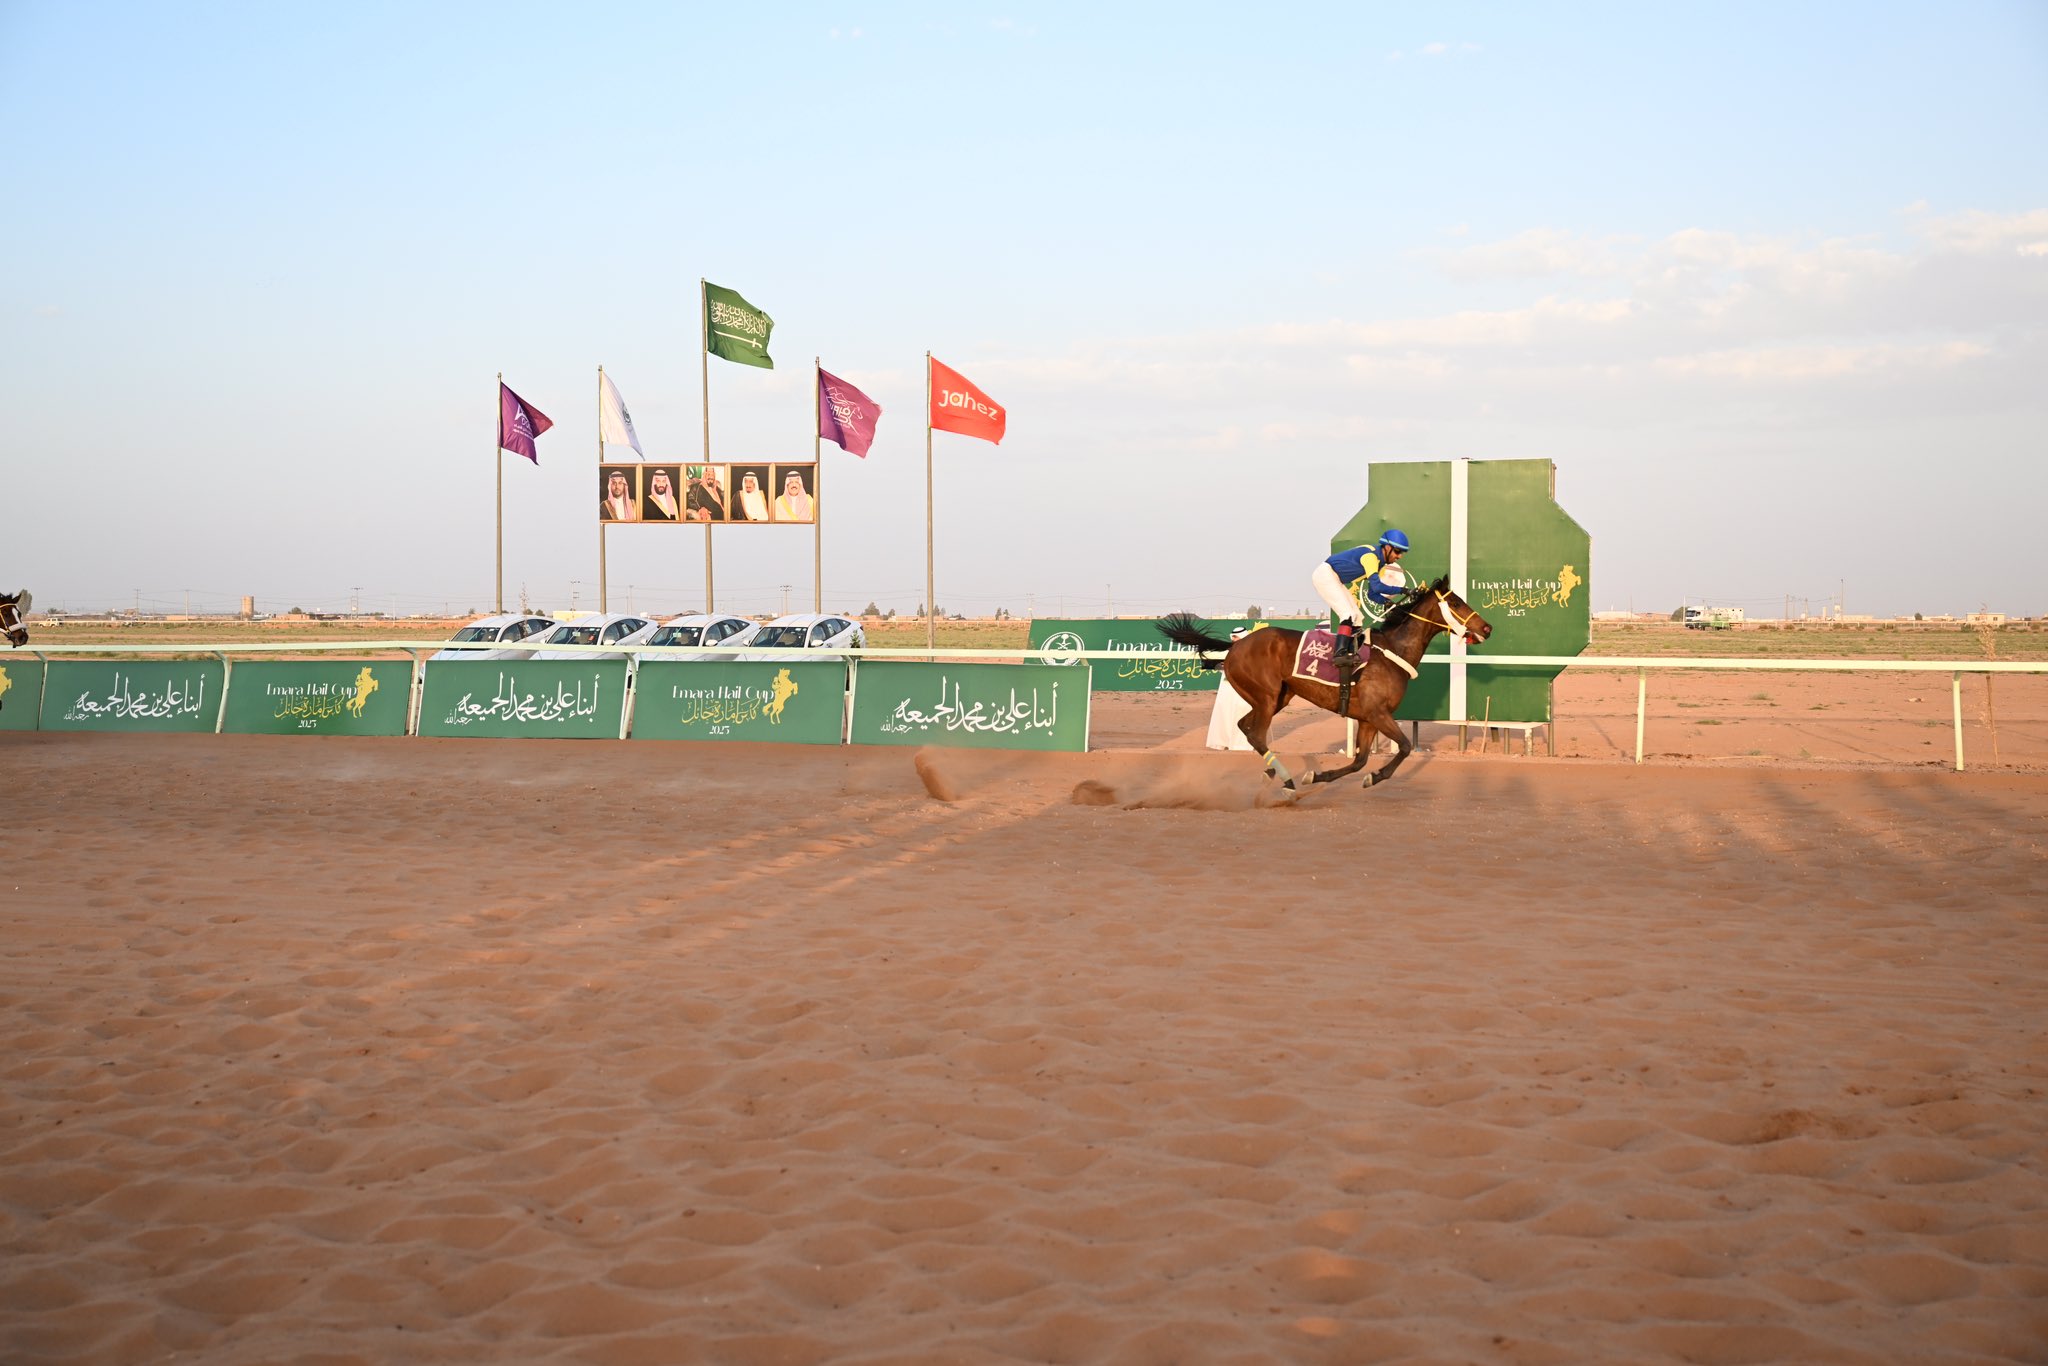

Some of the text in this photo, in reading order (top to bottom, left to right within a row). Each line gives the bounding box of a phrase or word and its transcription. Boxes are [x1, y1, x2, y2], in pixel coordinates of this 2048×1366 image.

[1155, 679, 1184, 690] 2025
[1306, 659, 1319, 676] 4
[152, 680, 183, 718] علي
[177, 673, 205, 719] أبناء
[541, 680, 576, 722] علي
[568, 673, 600, 723] أبناء
[992, 687, 1031, 734] علي
[1024, 681, 1059, 736] أبناء
